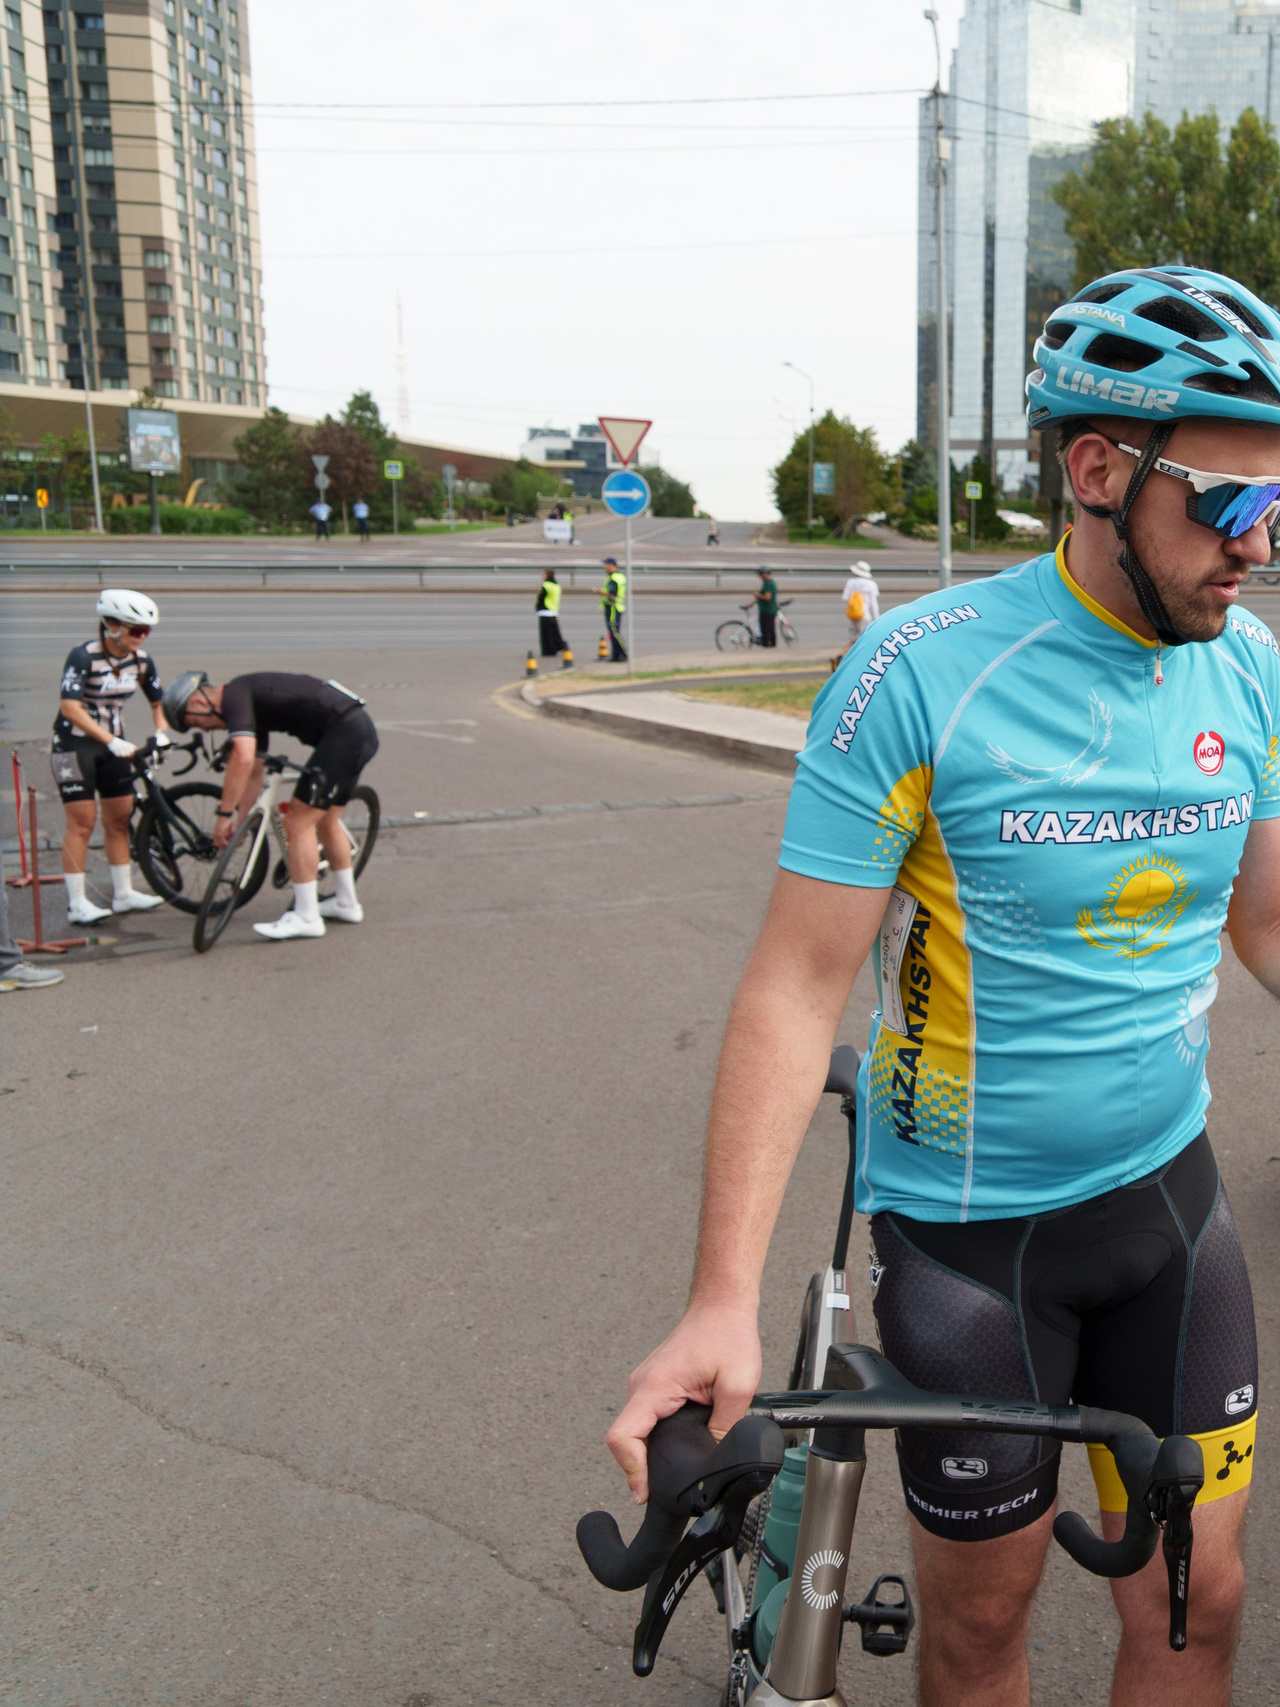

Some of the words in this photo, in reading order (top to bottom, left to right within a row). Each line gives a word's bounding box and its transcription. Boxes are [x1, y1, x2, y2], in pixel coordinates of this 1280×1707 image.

[1069, 304, 1126, 329] ASTANA
[1182, 287, 1252, 334] LIMAR
[1055, 365, 1180, 413] LIMAR
[830, 603, 982, 755] KAZAKHSTAN
[1198, 744, 1222, 760] MOA
[999, 789, 1254, 845] KAZAKHSTAN
[882, 932, 891, 970] Halyk
[983, 1487, 1038, 1518] TECH
